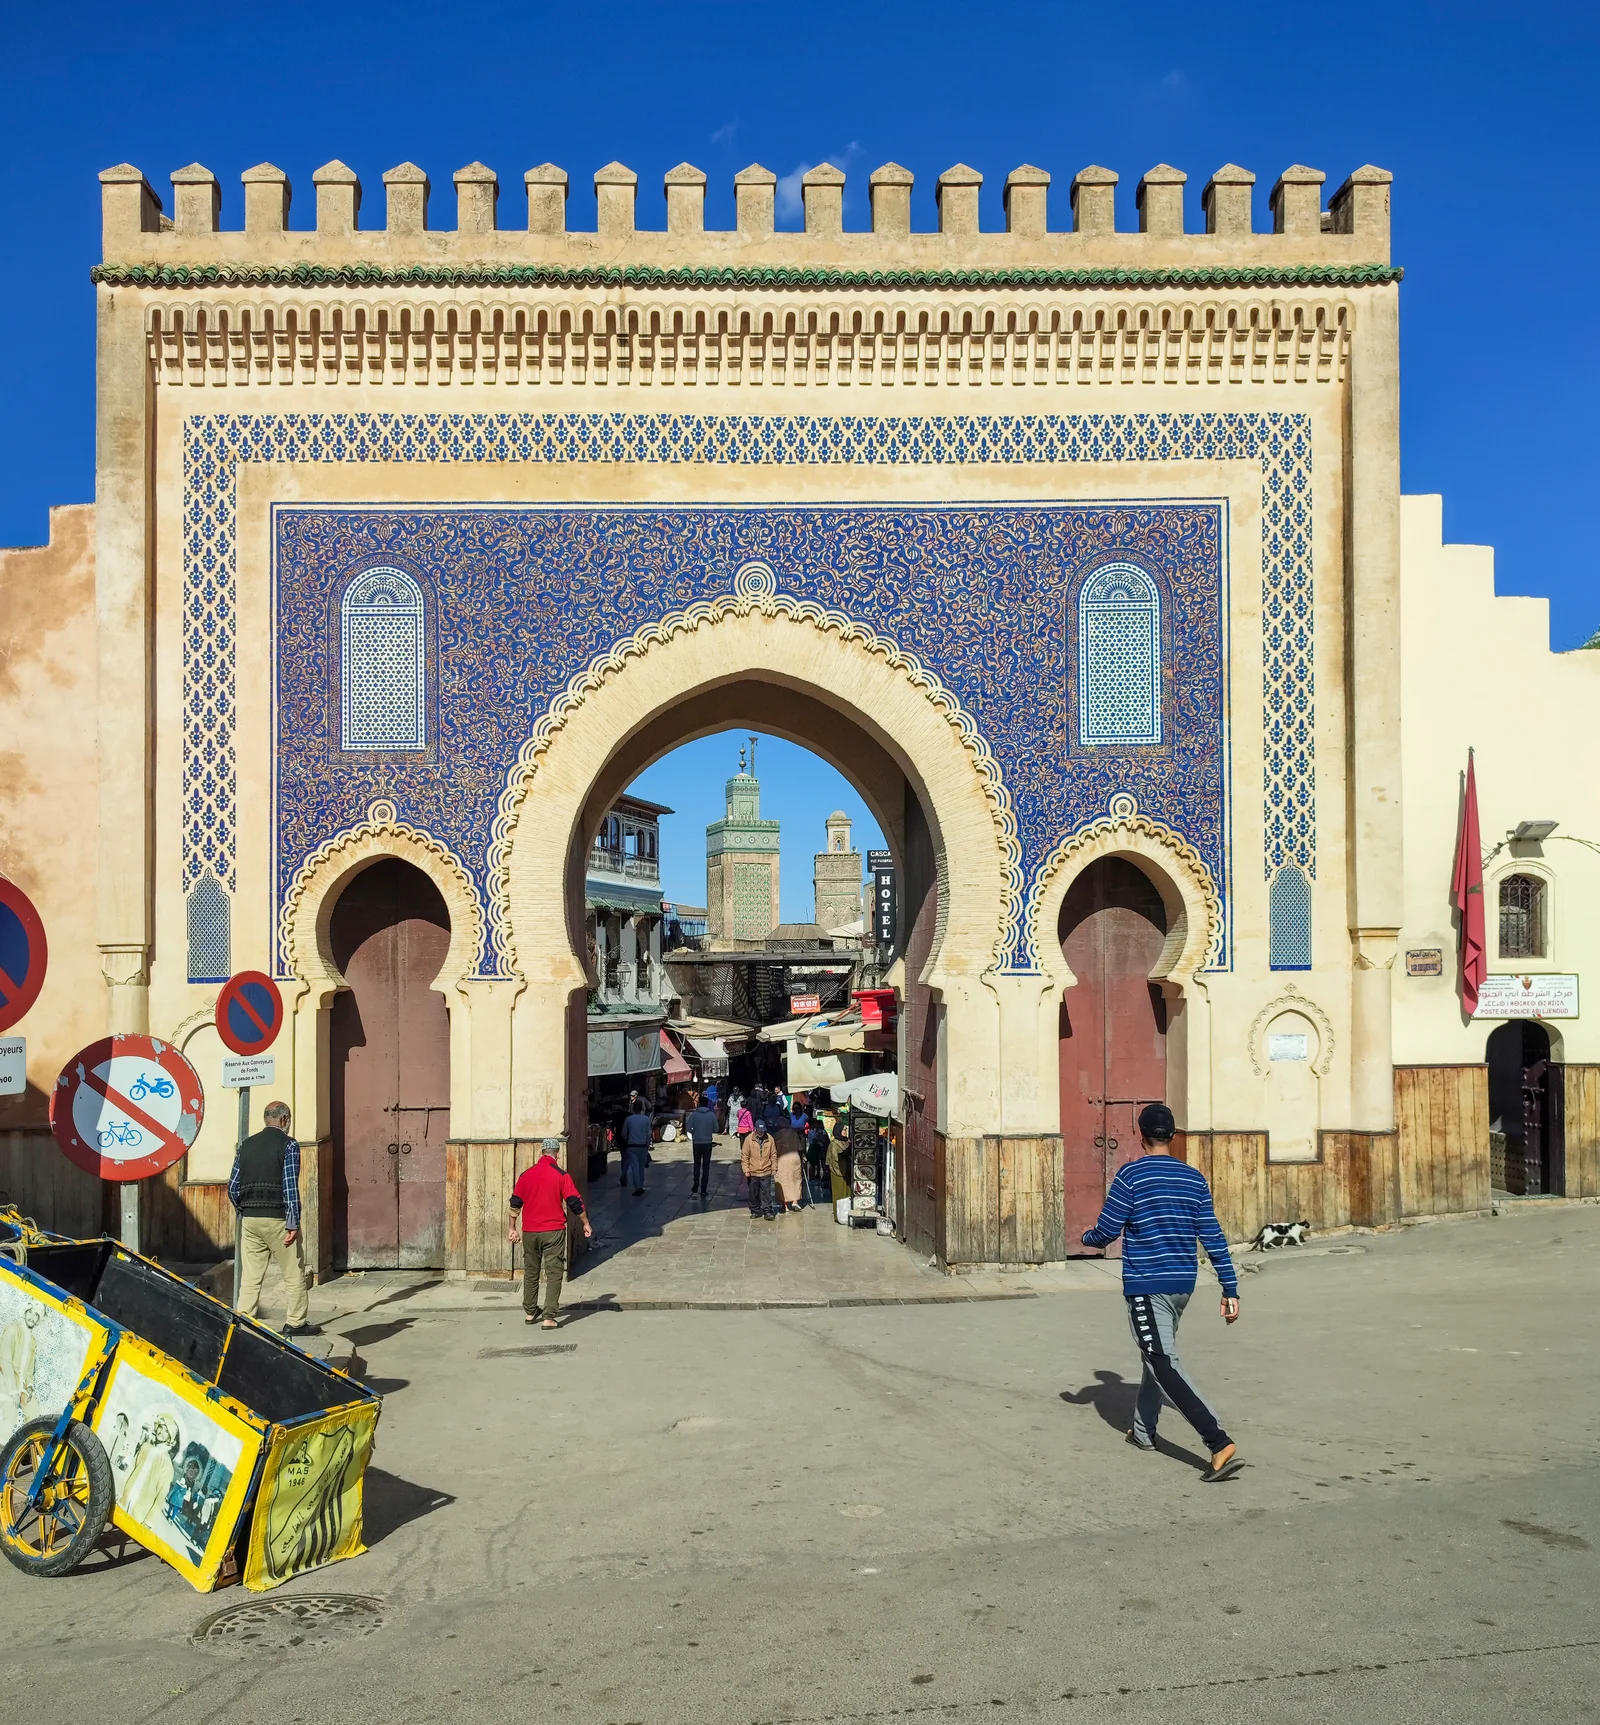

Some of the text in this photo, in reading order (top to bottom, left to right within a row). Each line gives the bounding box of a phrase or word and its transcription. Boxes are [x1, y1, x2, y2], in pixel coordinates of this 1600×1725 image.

[881, 875, 891, 938] HOTEL
[1505, 990, 1519, 998] أبي
[1521, 990, 1551, 998] الشرطة
[1554, 990, 1573, 998] مركز
[868, 1083, 890, 1098] Eight
[1134, 1296, 1153, 1341] ORDAN
[287, 1466, 310, 1475] MAS
[289, 1479, 306, 1488] 1946
